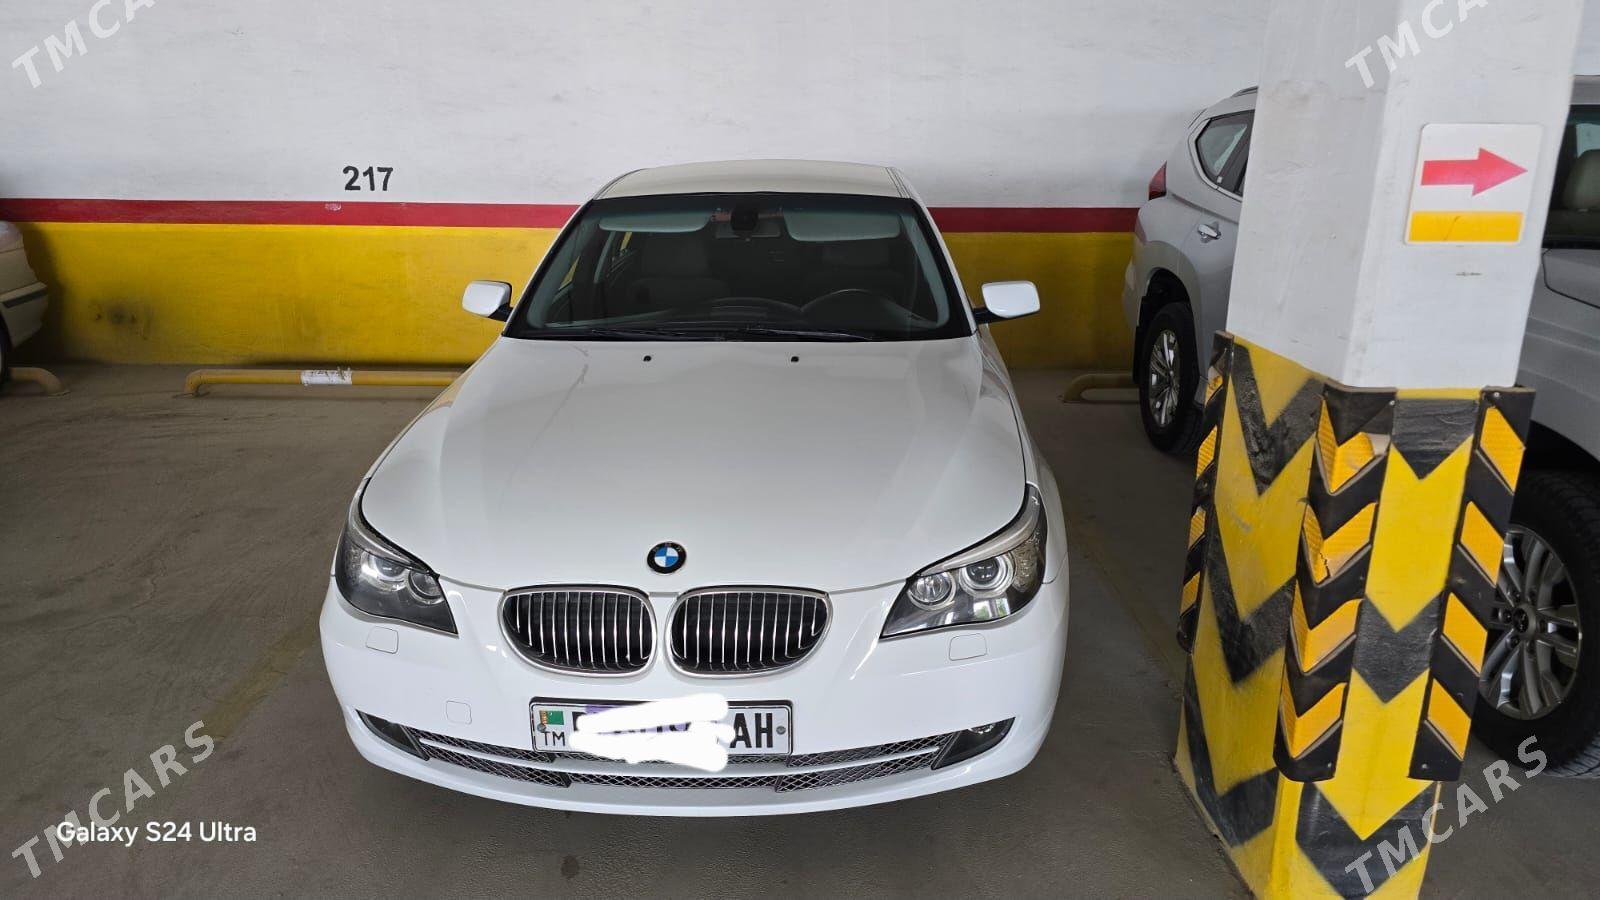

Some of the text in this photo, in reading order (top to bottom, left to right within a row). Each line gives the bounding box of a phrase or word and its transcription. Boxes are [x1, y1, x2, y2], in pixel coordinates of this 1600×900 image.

[342, 165, 394, 191] 217
[542, 731, 566, 747] TM
[729, 712, 774, 749] AH
